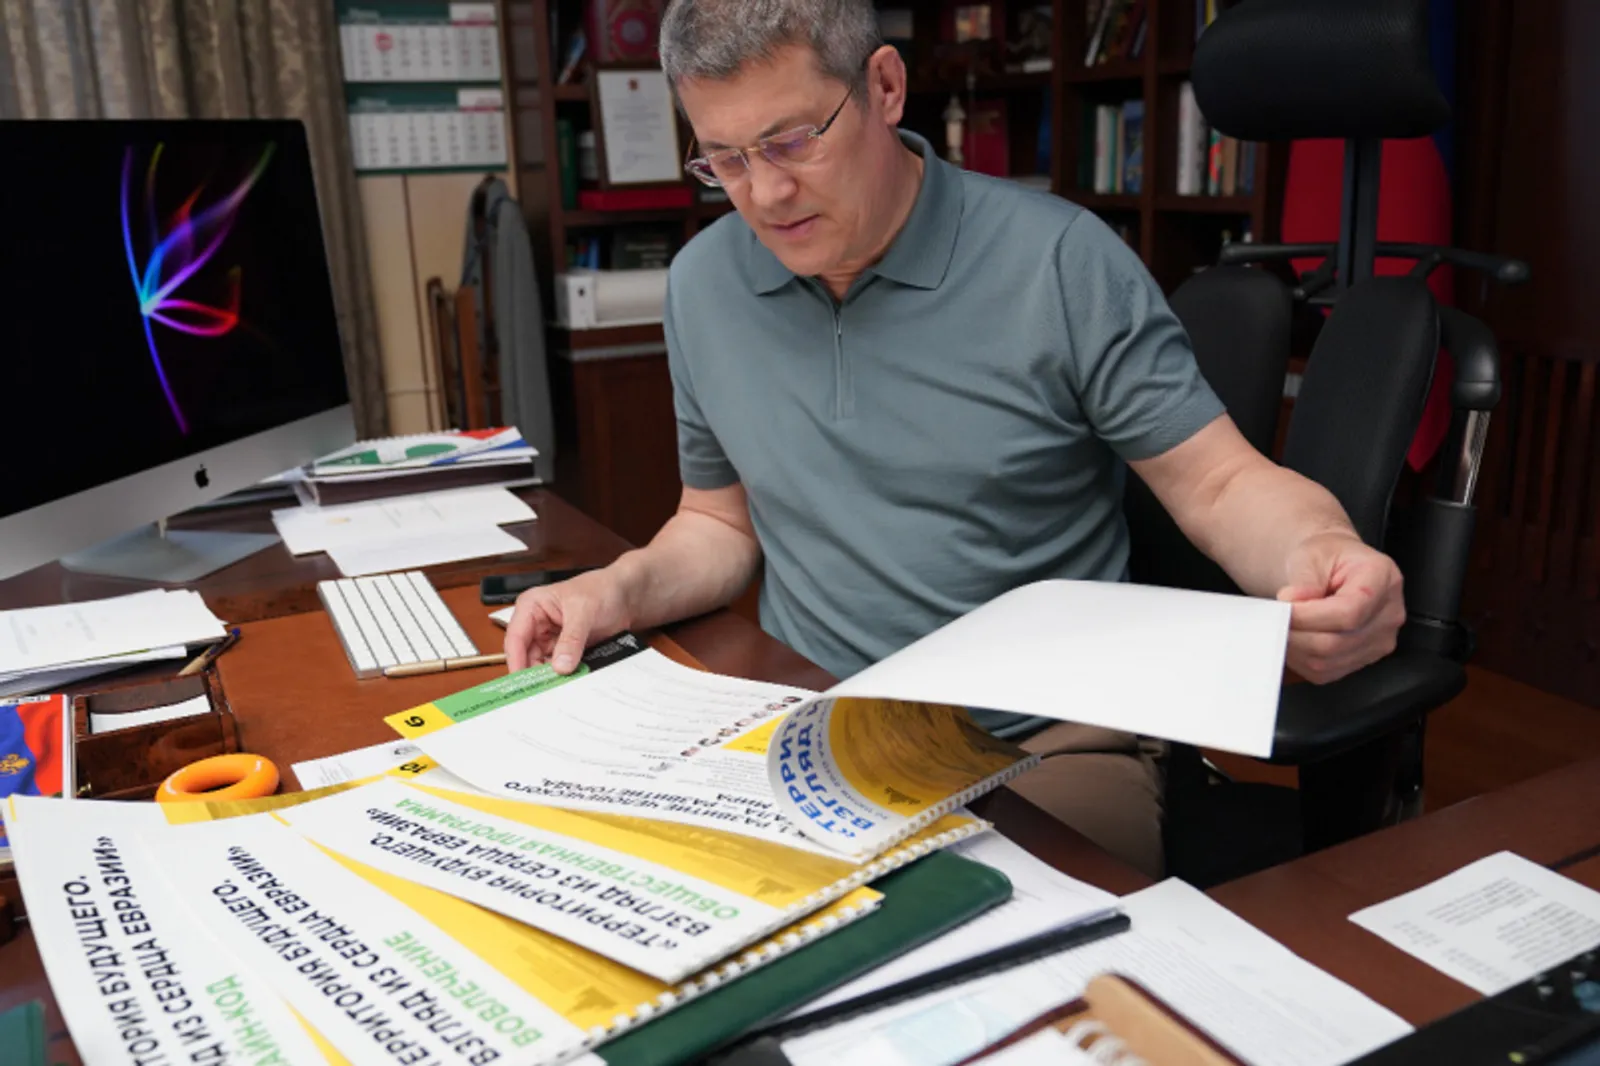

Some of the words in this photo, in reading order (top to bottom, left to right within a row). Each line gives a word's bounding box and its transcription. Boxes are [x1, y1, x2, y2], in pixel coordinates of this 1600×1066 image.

[779, 709, 856, 838] «ТЕРРИТ
[798, 722, 875, 830] ВЗГЛЯД
[366, 806, 469, 850] ЕВРАЗИИ»
[395, 797, 525, 846] ПРОГРАММА
[666, 803, 771, 829] РАЗВИТИЕ
[92, 835, 152, 936] ЕВРАЗИИ»
[227, 845, 311, 914] ЕВРАЗИИ»
[370, 831, 492, 881] БУДУЩЕГО.
[466, 843, 561, 880] СЕРДЦА
[518, 839, 741, 919] ОБЩЕСТВЕННАЯ
[557, 874, 601, 894] ИЗ
[63, 875, 132, 996] БУДУЩЕГО.
[212, 879, 312, 962] БУДУЩЕГО.
[297, 910, 380, 968] СЕРДЦА
[487, 875, 678, 950] «ТЕРРИТОРИЯ
[597, 886, 711, 937] ВЗГЛЯД
[131, 937, 193, 1014] СЕРДЦА
[368, 966, 412, 995] ИЗ
[383, 930, 544, 1047] ВОВЛЕЧЕНИЕ
[107, 996, 171, 1066] ТОРИЯ
[172, 1014, 211, 1047] ИЗ
[204, 973, 293, 1066] АЙН-КОД
[399, 988, 501, 1066] ВЗГЛЯД
